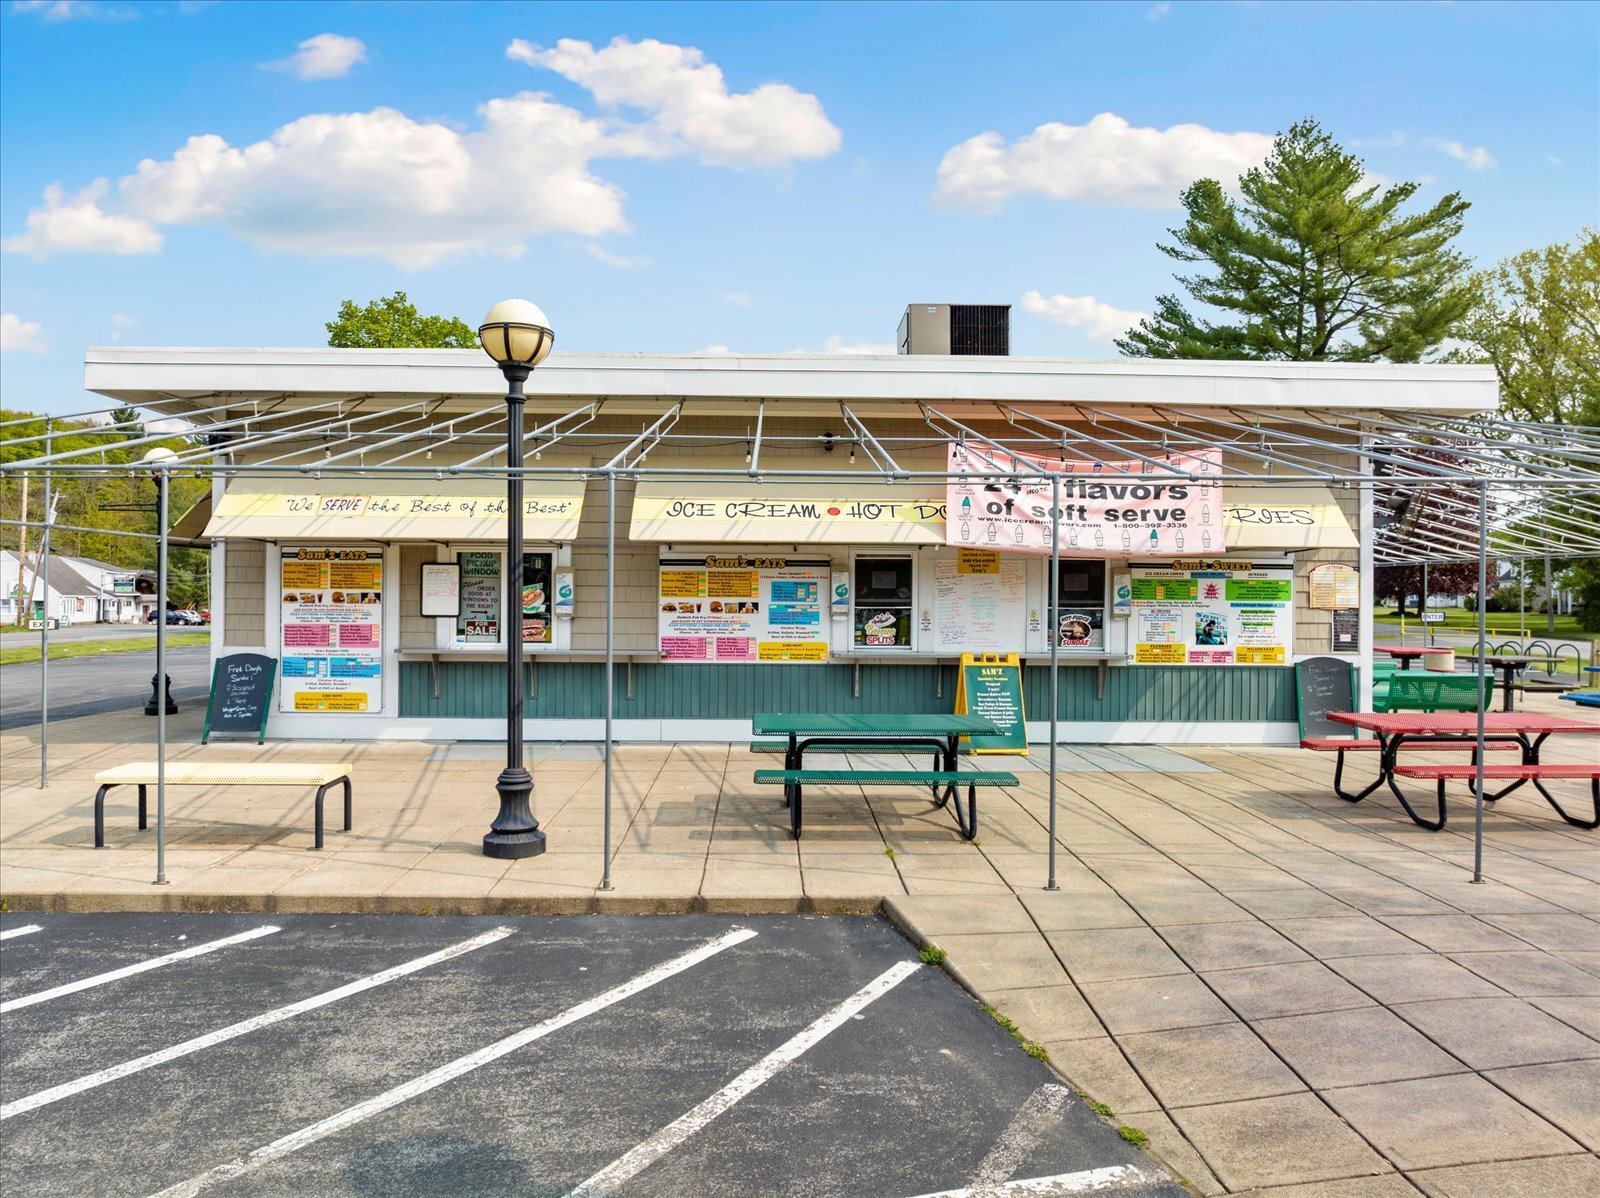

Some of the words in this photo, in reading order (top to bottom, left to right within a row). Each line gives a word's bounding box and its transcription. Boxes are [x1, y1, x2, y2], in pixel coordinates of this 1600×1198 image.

[1064, 479, 1188, 500] flavors
[322, 500, 360, 511] SERVE
[368, 500, 400, 511] the
[410, 501, 450, 512] Best
[484, 501, 508, 513] th
[666, 502, 715, 517] ICE
[726, 503, 820, 518] CREAM
[846, 504, 902, 519] HOT
[914, 506, 946, 520] DO
[986, 499, 1014, 516] of
[1031, 505, 1087, 522] soft
[1104, 507, 1186, 522] serve
[977, 517, 1101, 528] www.icecreamfavors.com
[298, 549, 336, 560] Sam'z
[339, 552, 367, 560] EATS
[705, 555, 748, 568] Sam'z
[754, 558, 786, 568] EATS
[1172, 560, 1208, 571] Sam'z
[1212, 560, 1254, 571] SWEETS
[467, 627, 496, 635] SALE
